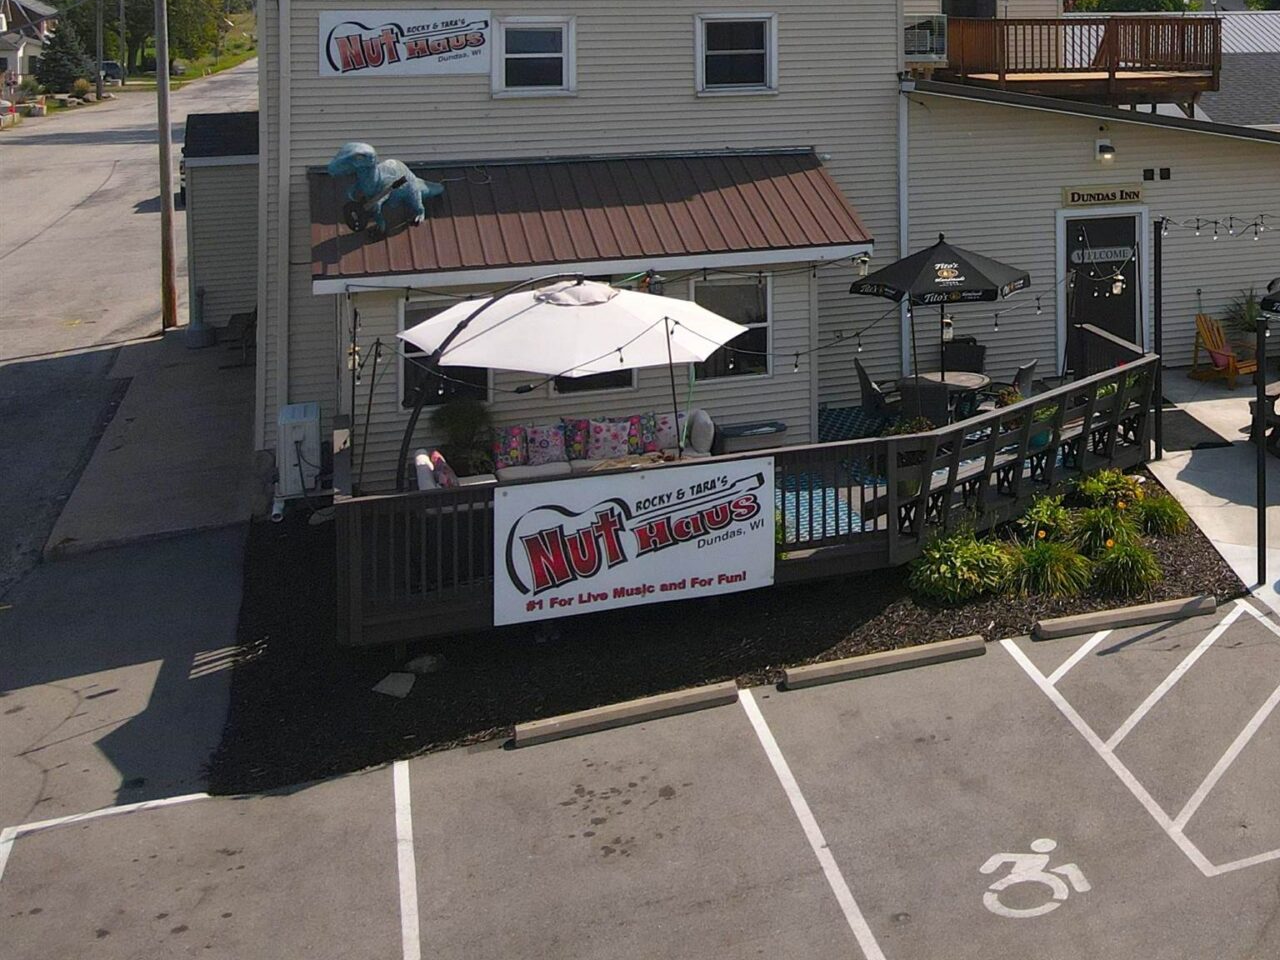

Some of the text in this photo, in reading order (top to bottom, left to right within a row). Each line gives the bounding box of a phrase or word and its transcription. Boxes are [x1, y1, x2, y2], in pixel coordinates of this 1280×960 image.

[406, 25, 430, 34] ROCKY
[441, 18, 465, 28] TARA'S
[335, 27, 486, 73] Nut Haus
[438, 52, 469, 63] Dundas,
[924, 292, 948, 303] Tito's
[636, 475, 729, 512] ROCKY & TARA'S
[520, 493, 761, 595] Nut Haus
[698, 519, 765, 549] Dundas, WI
[526, 571, 746, 612] #1 For Live Music and For Fun!
